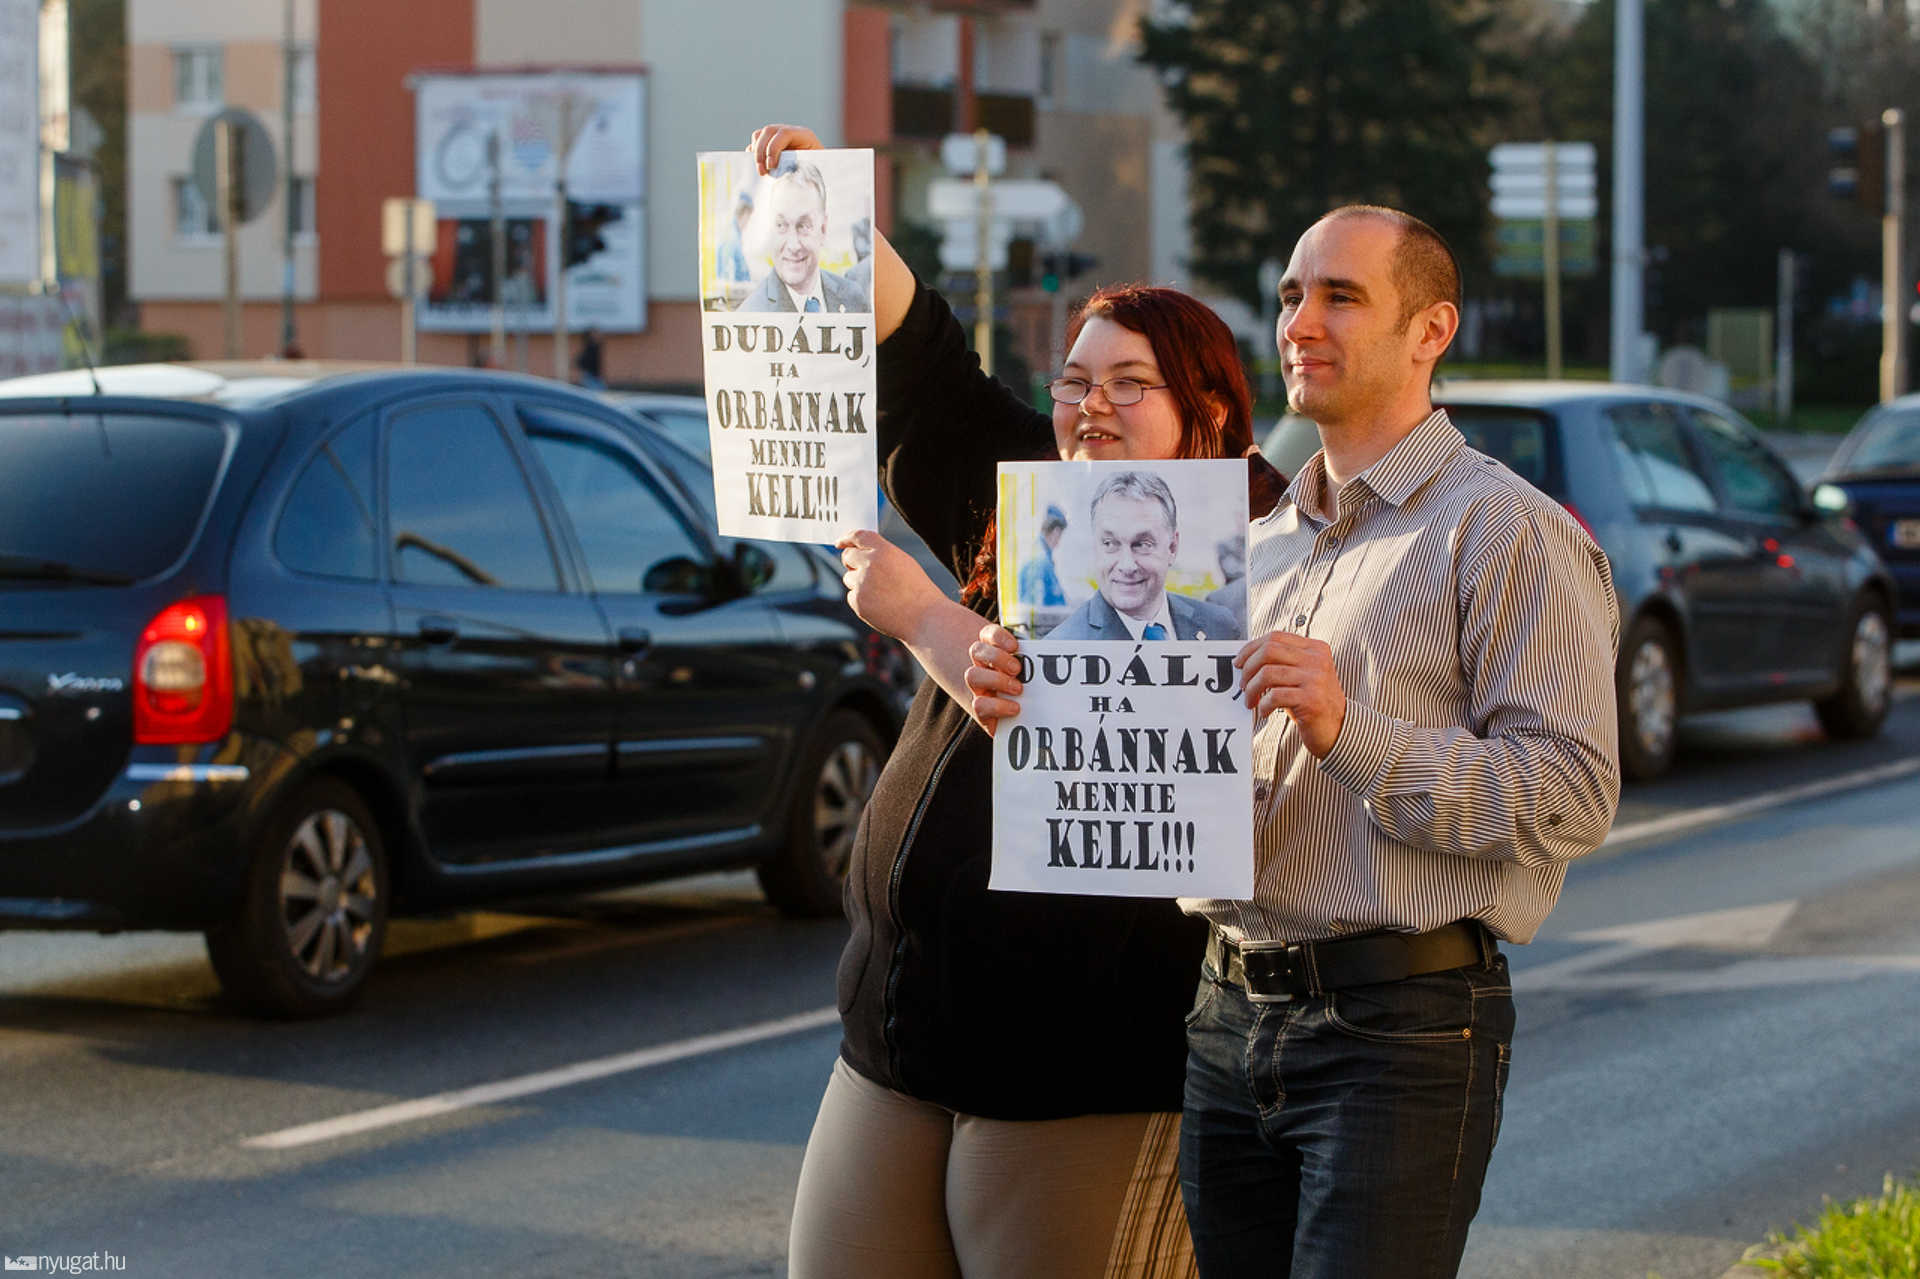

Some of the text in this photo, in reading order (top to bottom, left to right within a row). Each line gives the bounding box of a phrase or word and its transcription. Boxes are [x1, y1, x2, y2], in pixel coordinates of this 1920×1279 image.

[711, 316, 870, 368] DUDÁLJ,
[770, 362, 799, 378] HA
[716, 379, 867, 434] ORBÁNNAK
[750, 438, 826, 469] MENNIE
[746, 472, 838, 523] KELL!!!
[1089, 696, 1136, 713] HA
[1007, 714, 1238, 774] ORBÁNNAK
[1055, 781, 1176, 813] MENNIE
[1046, 818, 1195, 873] KELL!!!
